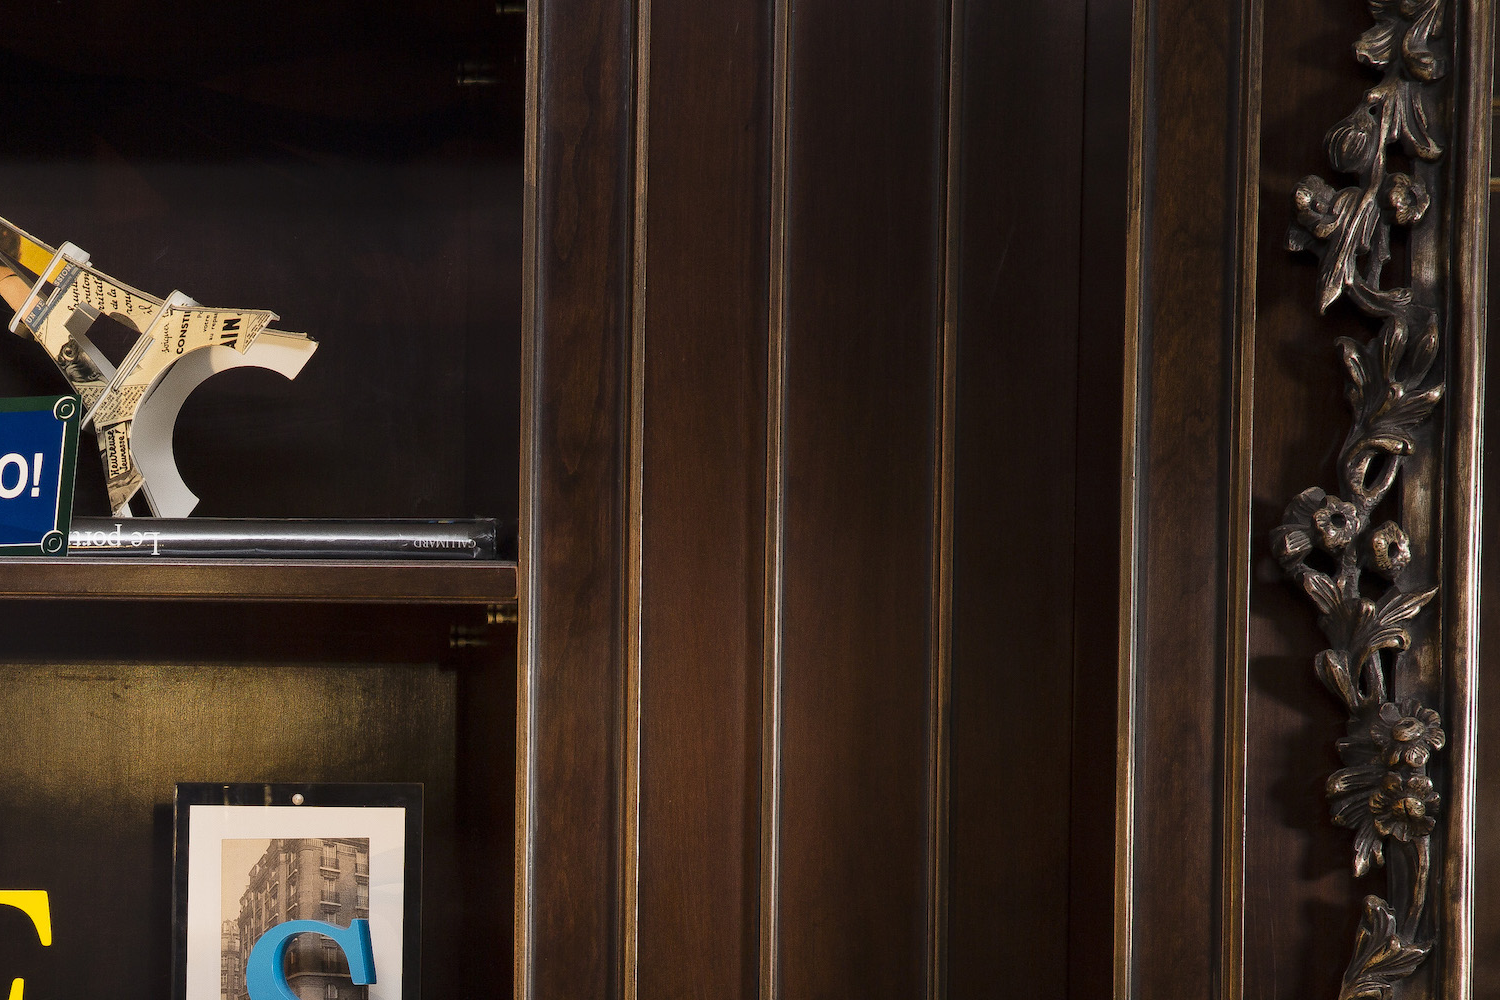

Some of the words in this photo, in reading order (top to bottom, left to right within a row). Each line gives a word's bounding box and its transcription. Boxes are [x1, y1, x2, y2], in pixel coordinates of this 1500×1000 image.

[69, 523, 122, 548] port
[131, 531, 160, 556] Le
[414, 539, 477, 549] GALLIMARD
